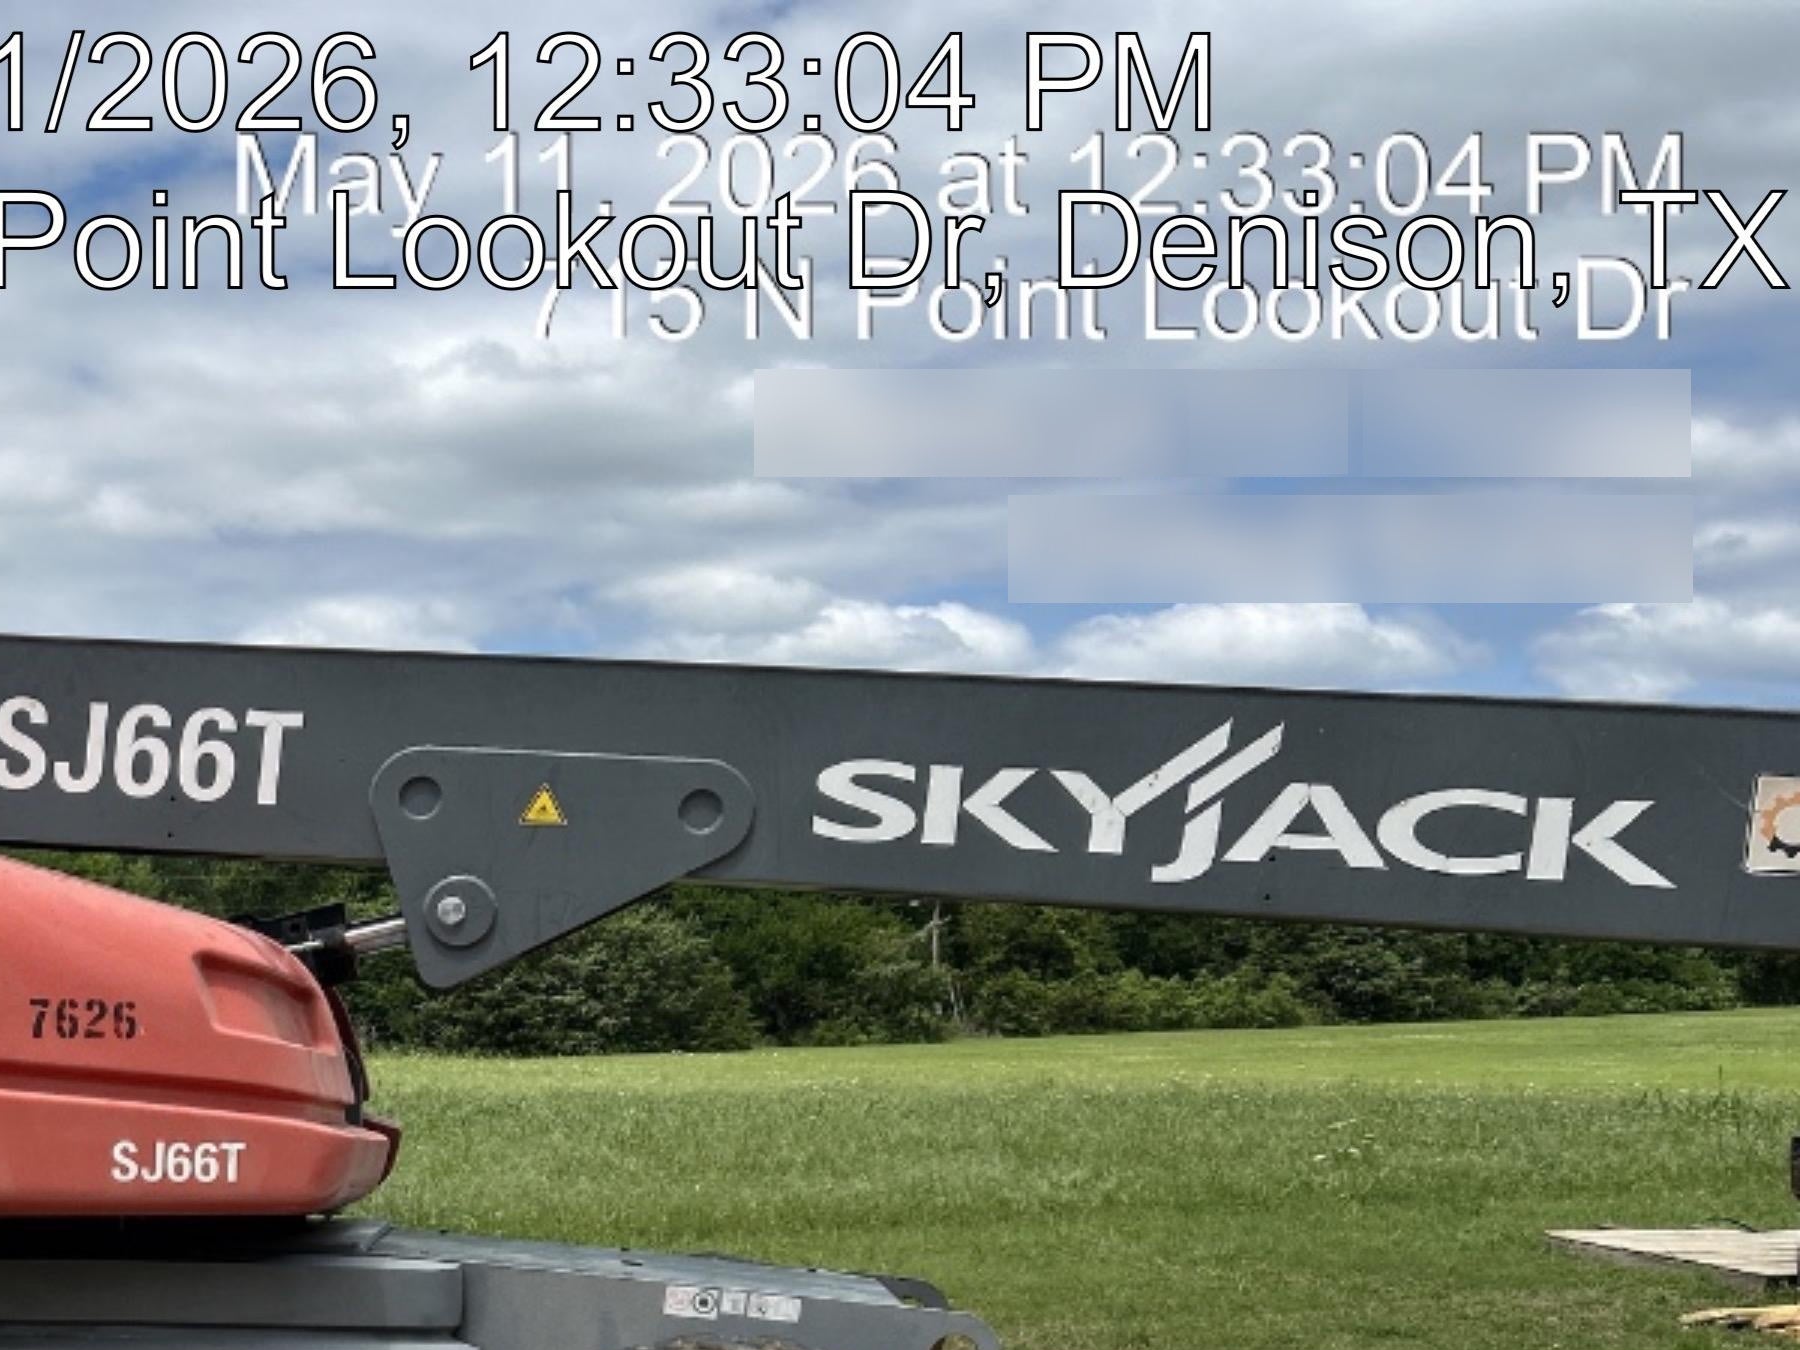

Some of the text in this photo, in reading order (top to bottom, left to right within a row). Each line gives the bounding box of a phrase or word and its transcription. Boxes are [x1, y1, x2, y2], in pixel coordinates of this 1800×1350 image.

[810, 717, 1679, 889] SKYJACK
[29, 998, 137, 1039] 7626
[111, 1139, 247, 1184] SJ66T
